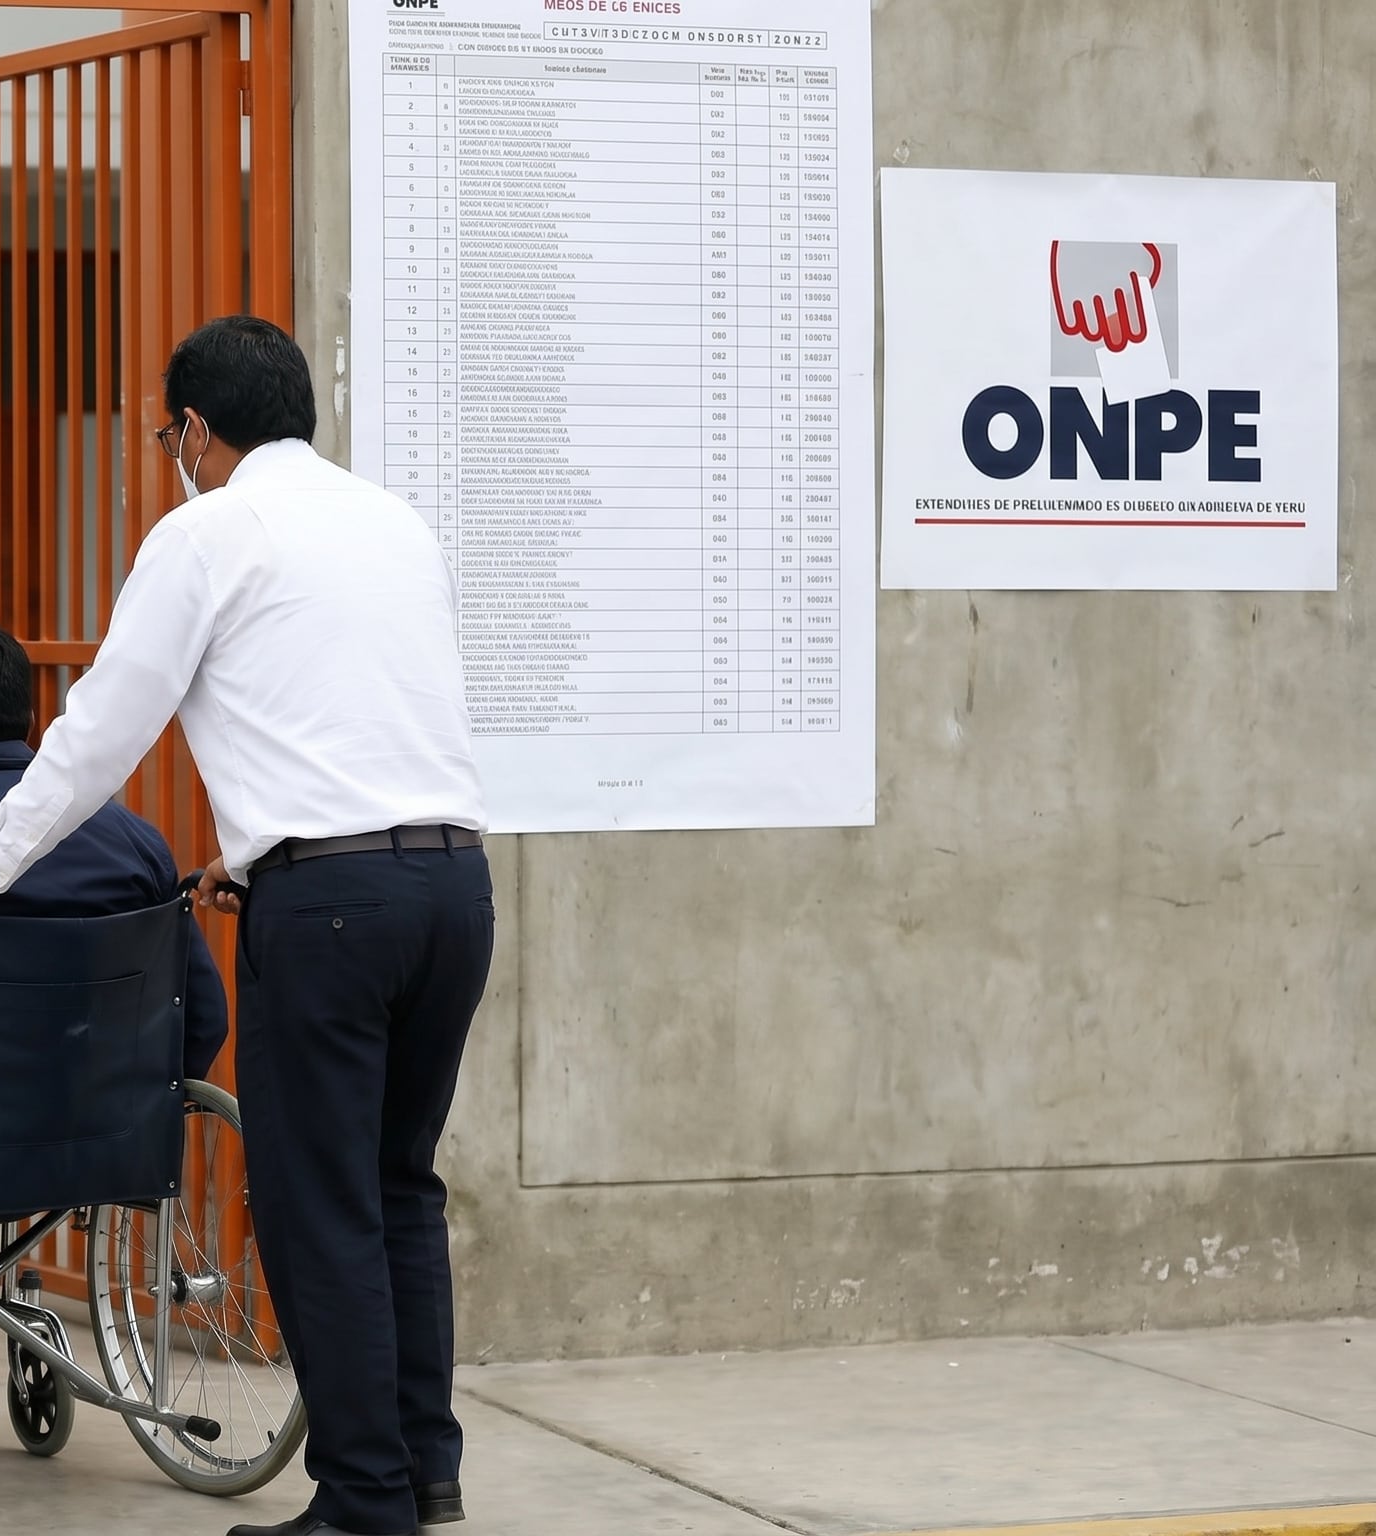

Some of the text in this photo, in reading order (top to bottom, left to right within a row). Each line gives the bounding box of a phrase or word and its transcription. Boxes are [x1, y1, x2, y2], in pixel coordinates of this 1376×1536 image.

[589, 0, 607, 11] DE
[633, 2, 681, 14] ENICES
[407, 81, 414, 89] 1
[408, 101, 414, 110] 2
[408, 121, 415, 130] 3
[407, 142, 415, 151] 4
[408, 183, 415, 191] 6
[408, 203, 415, 211] 7
[408, 223, 415, 232] 8
[408, 244, 415, 253] 9
[407, 264, 418, 273] 10
[407, 284, 417, 292] 11
[407, 305, 417, 314] 12
[407, 326, 418, 335] 13
[407, 346, 418, 355] 14
[962, 385, 1261, 482] ONPE
[407, 491, 419, 500] 20
[994, 499, 1010, 511] DE
[1106, 500, 1120, 511] ES
[1256, 502, 1273, 513] DE
[1275, 502, 1306, 513] YERU
